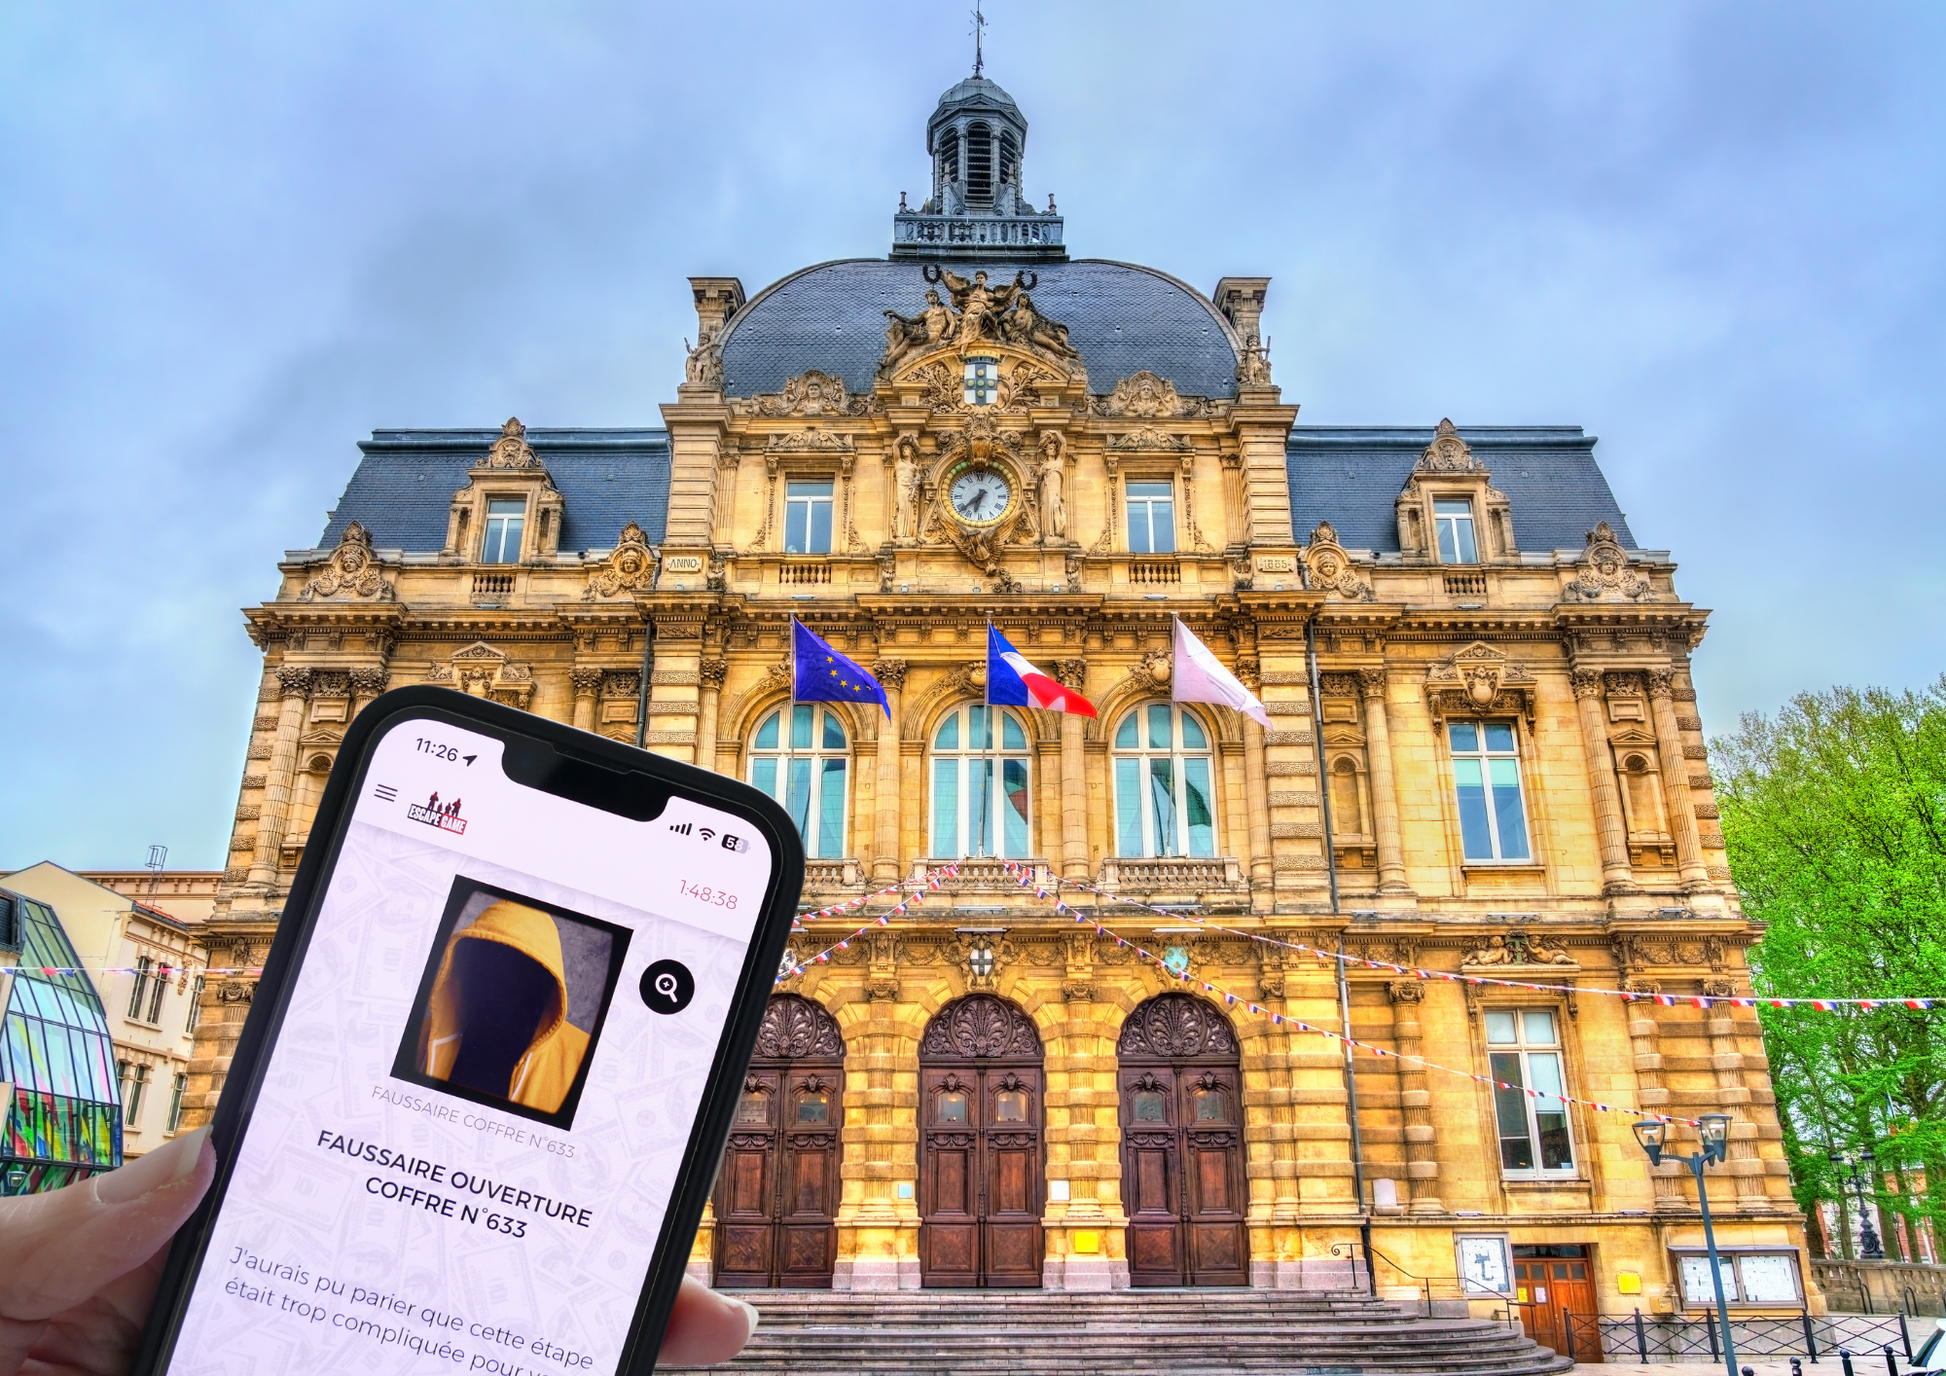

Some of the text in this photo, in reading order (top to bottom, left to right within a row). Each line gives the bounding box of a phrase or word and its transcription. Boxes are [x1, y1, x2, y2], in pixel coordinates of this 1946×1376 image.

[416, 738, 459, 762] 11:26
[408, 805, 466, 833] ESCAPE GAME
[726, 837, 743, 851] 58
[680, 880, 738, 910] 1:48:38
[371, 1086, 460, 1123] FAUSSAIRE
[463, 1114, 526, 1144] COFFRE
[318, 1130, 593, 1228] FAUSSAIRE OUVERTURE
[366, 1177, 457, 1218] COFFRE
[225, 1277, 524, 1376] était trop compliquée pour
[230, 1246, 594, 1370] J'aurais pu parier que cette étape
